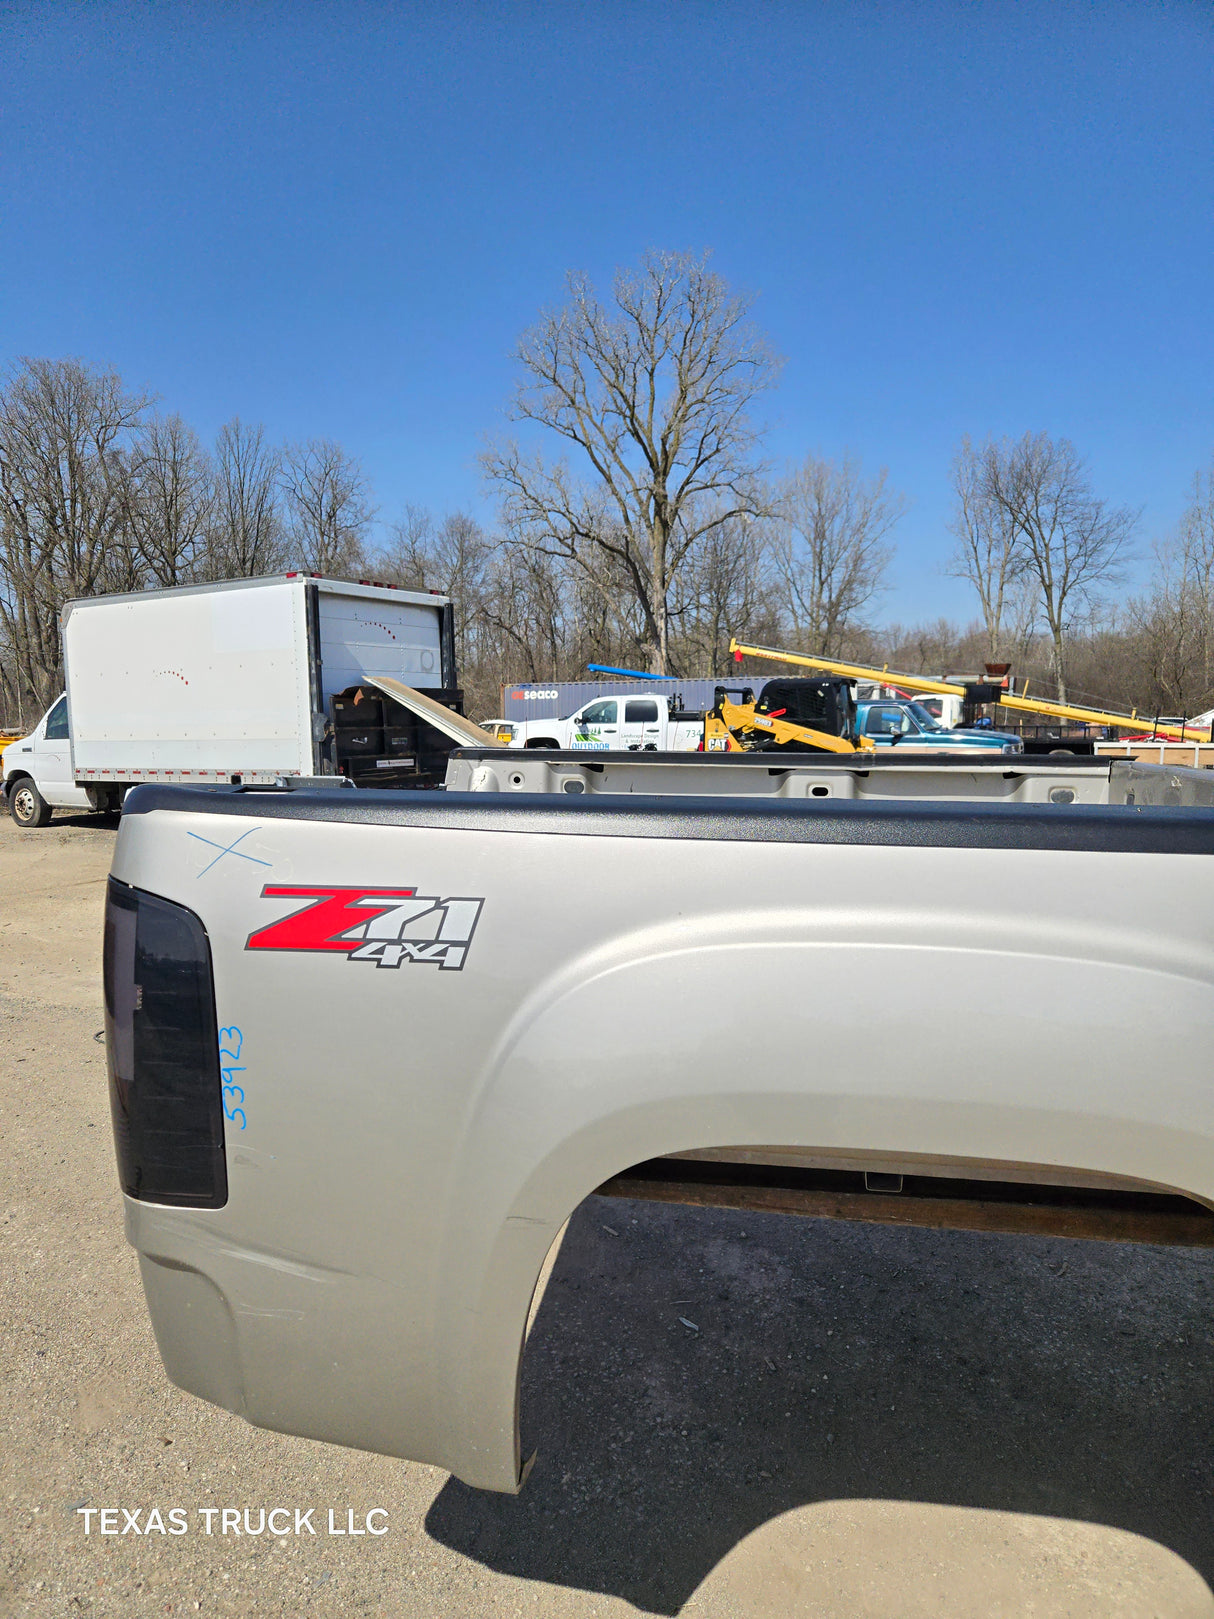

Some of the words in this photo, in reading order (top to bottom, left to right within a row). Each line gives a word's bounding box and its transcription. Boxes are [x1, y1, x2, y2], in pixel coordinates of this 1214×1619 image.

[571, 742, 610, 751] OUTDOOR
[708, 738, 727, 751] CAT
[244, 884, 485, 951] Z71
[219, 1026, 247, 1131] 53923
